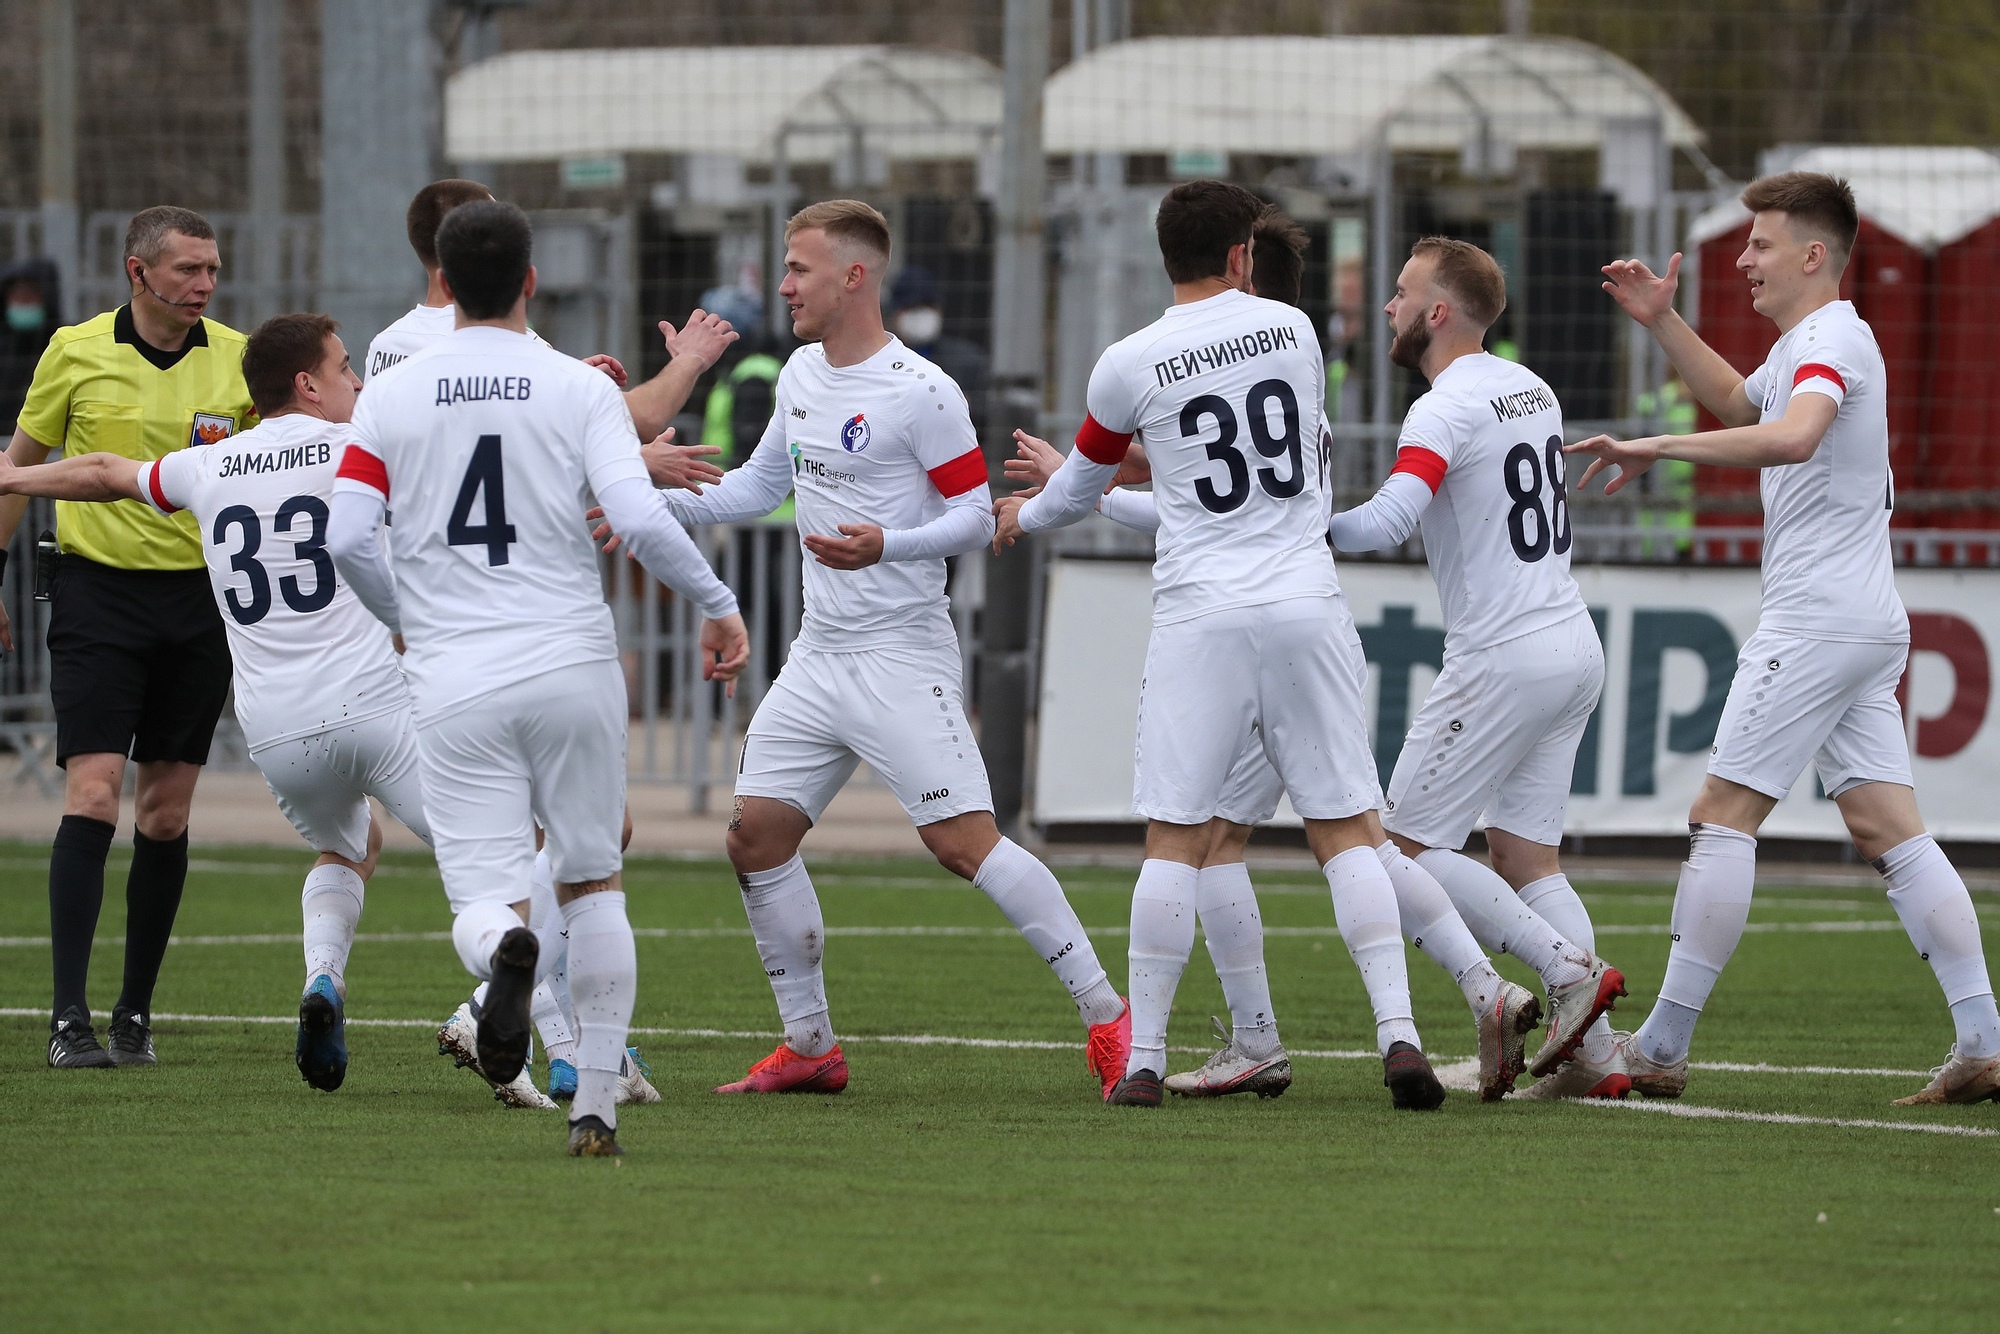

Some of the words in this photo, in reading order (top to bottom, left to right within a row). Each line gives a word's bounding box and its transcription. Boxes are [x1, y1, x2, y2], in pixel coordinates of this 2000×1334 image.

[1155, 326, 1298, 388] ПЕЙЧИНОВИЧ
[436, 376, 531, 406] ДАШАЕВ
[791, 407, 806, 419] JAKO
[218, 442, 331, 478] ЗАМАЛИЕВ
[1179, 378, 1305, 514] 39
[447, 434, 516, 566] 4
[1503, 434, 1572, 563] 88
[213, 495, 337, 626] 33
[920, 787, 950, 803] JAKO
